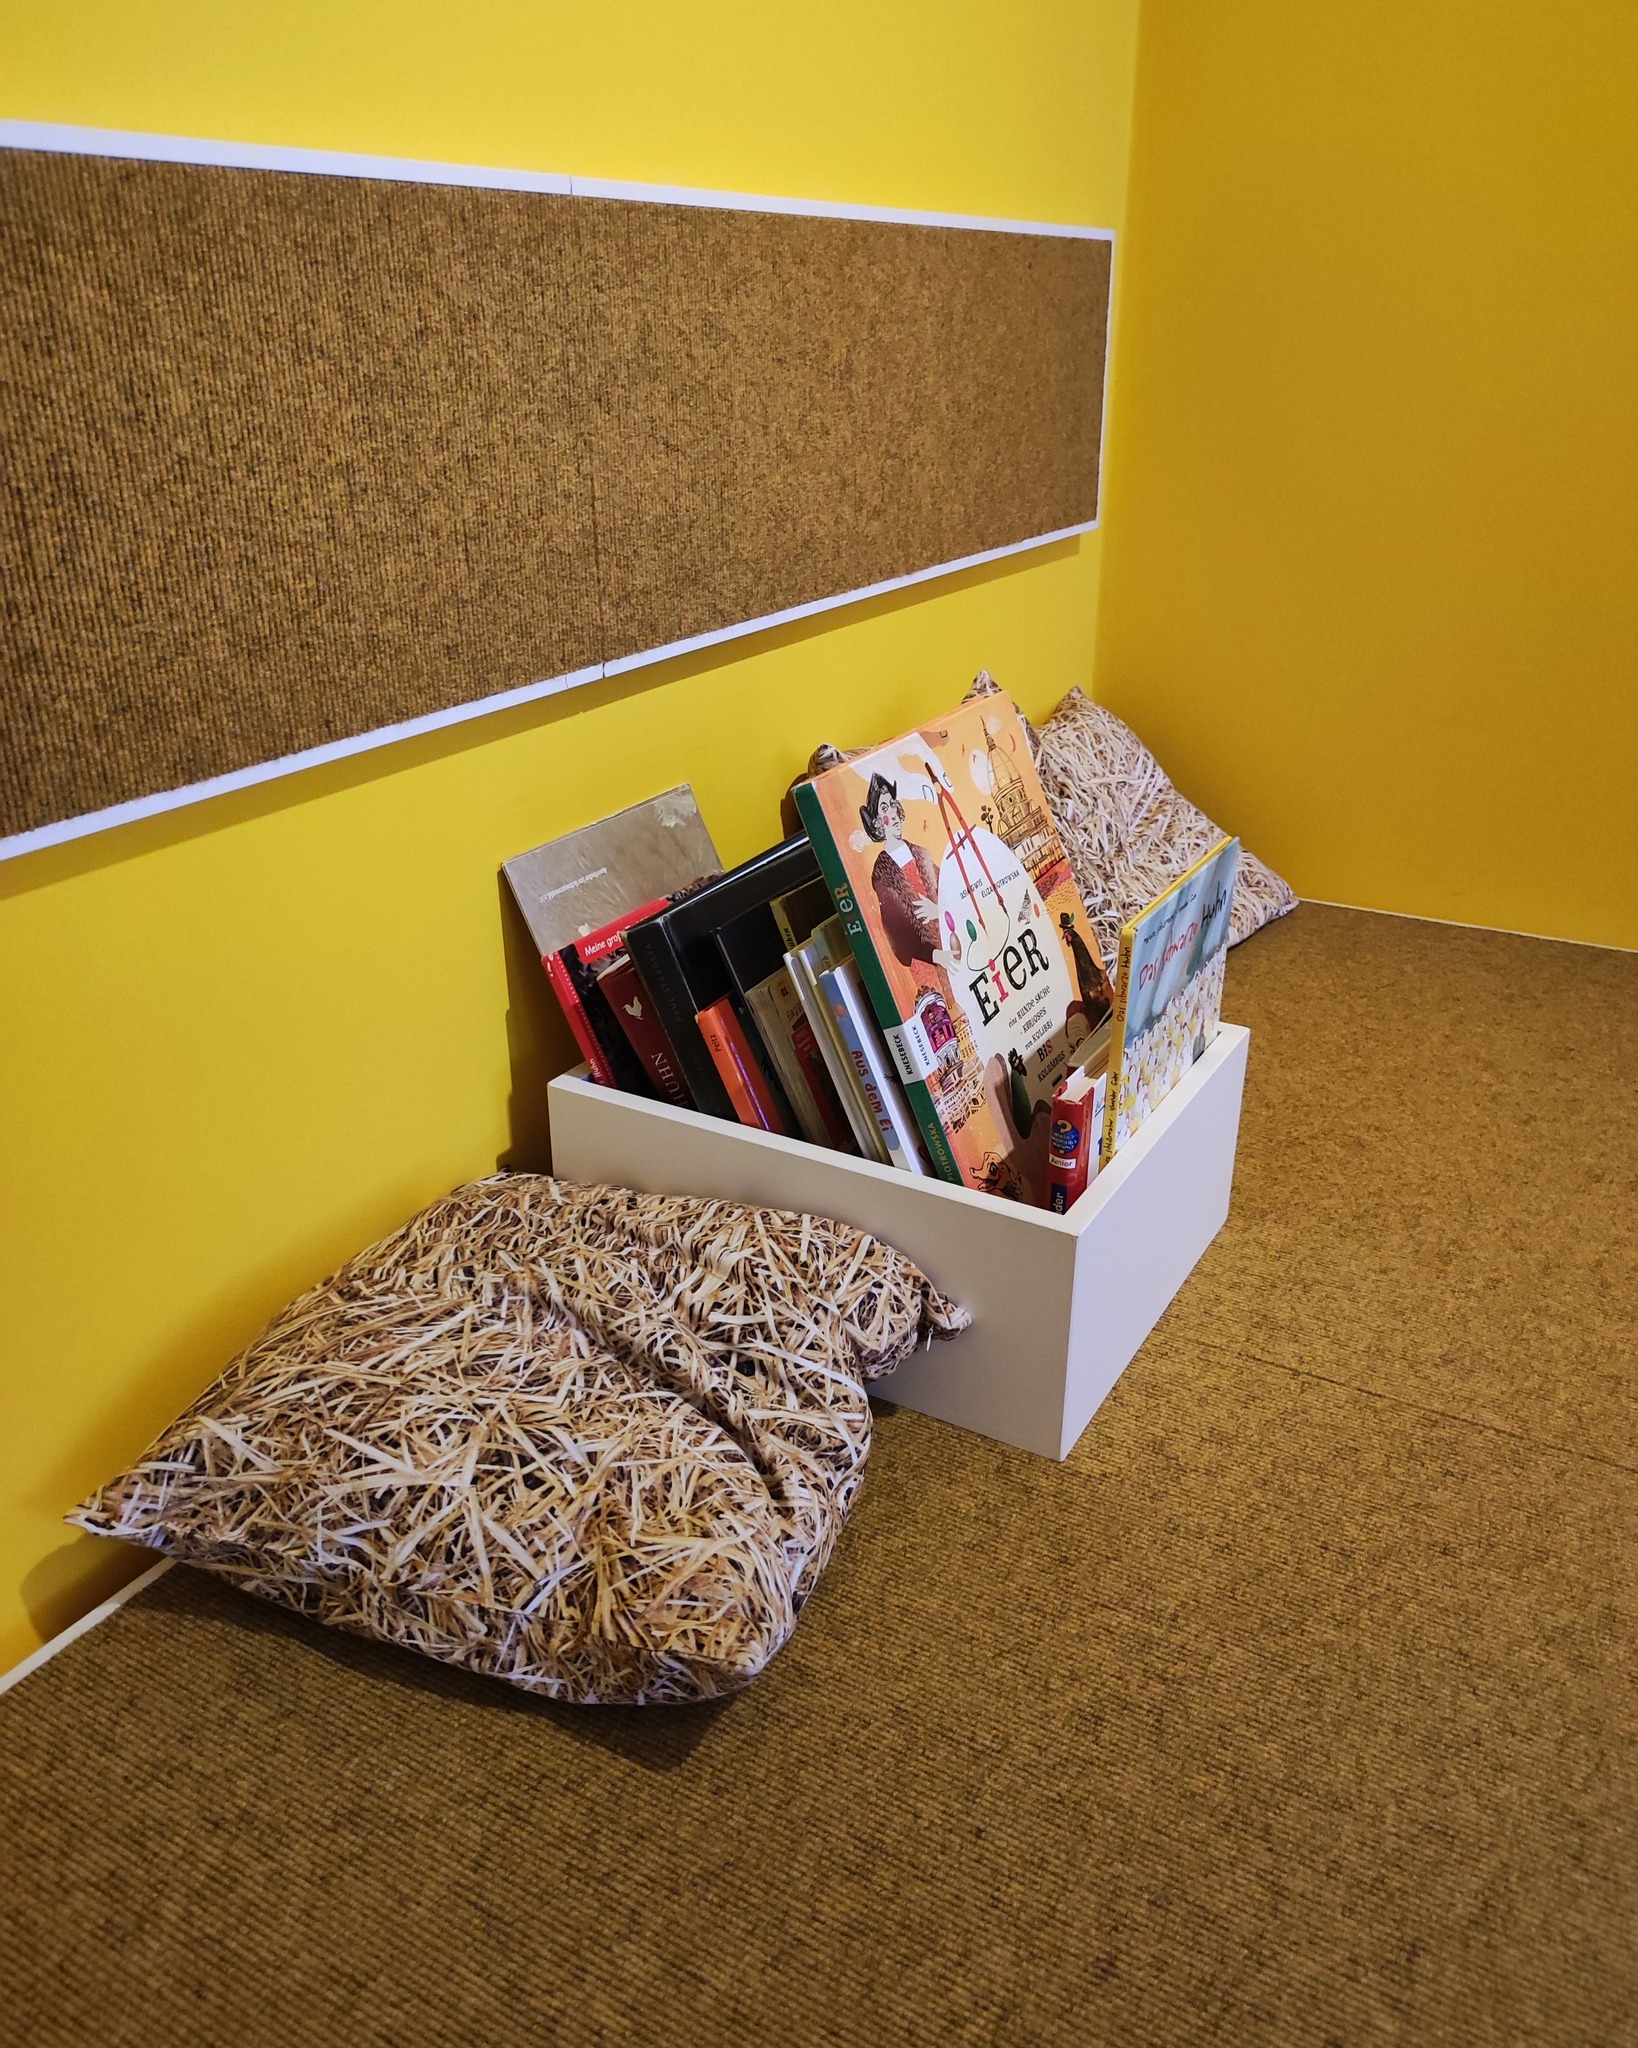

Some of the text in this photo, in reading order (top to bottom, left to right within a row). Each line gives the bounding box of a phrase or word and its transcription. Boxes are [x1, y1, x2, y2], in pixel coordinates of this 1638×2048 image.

[1201, 880, 1226, 929] Huhn
[584, 941, 606, 957] Meine
[1119, 946, 1131, 968] Huhn
[1117, 1007, 1126, 1022] Das
[893, 1034, 913, 1075] KNESEBECK
[912, 1025, 930, 1066] KNESEBECK
[590, 1058, 601, 1079] Huhn
[651, 1052, 688, 1106] HUHN
[852, 1050, 893, 1132] Aus dem Ei
[928, 1122, 954, 1180] PIOTROWSKA
[1052, 1192, 1064, 1214] der
